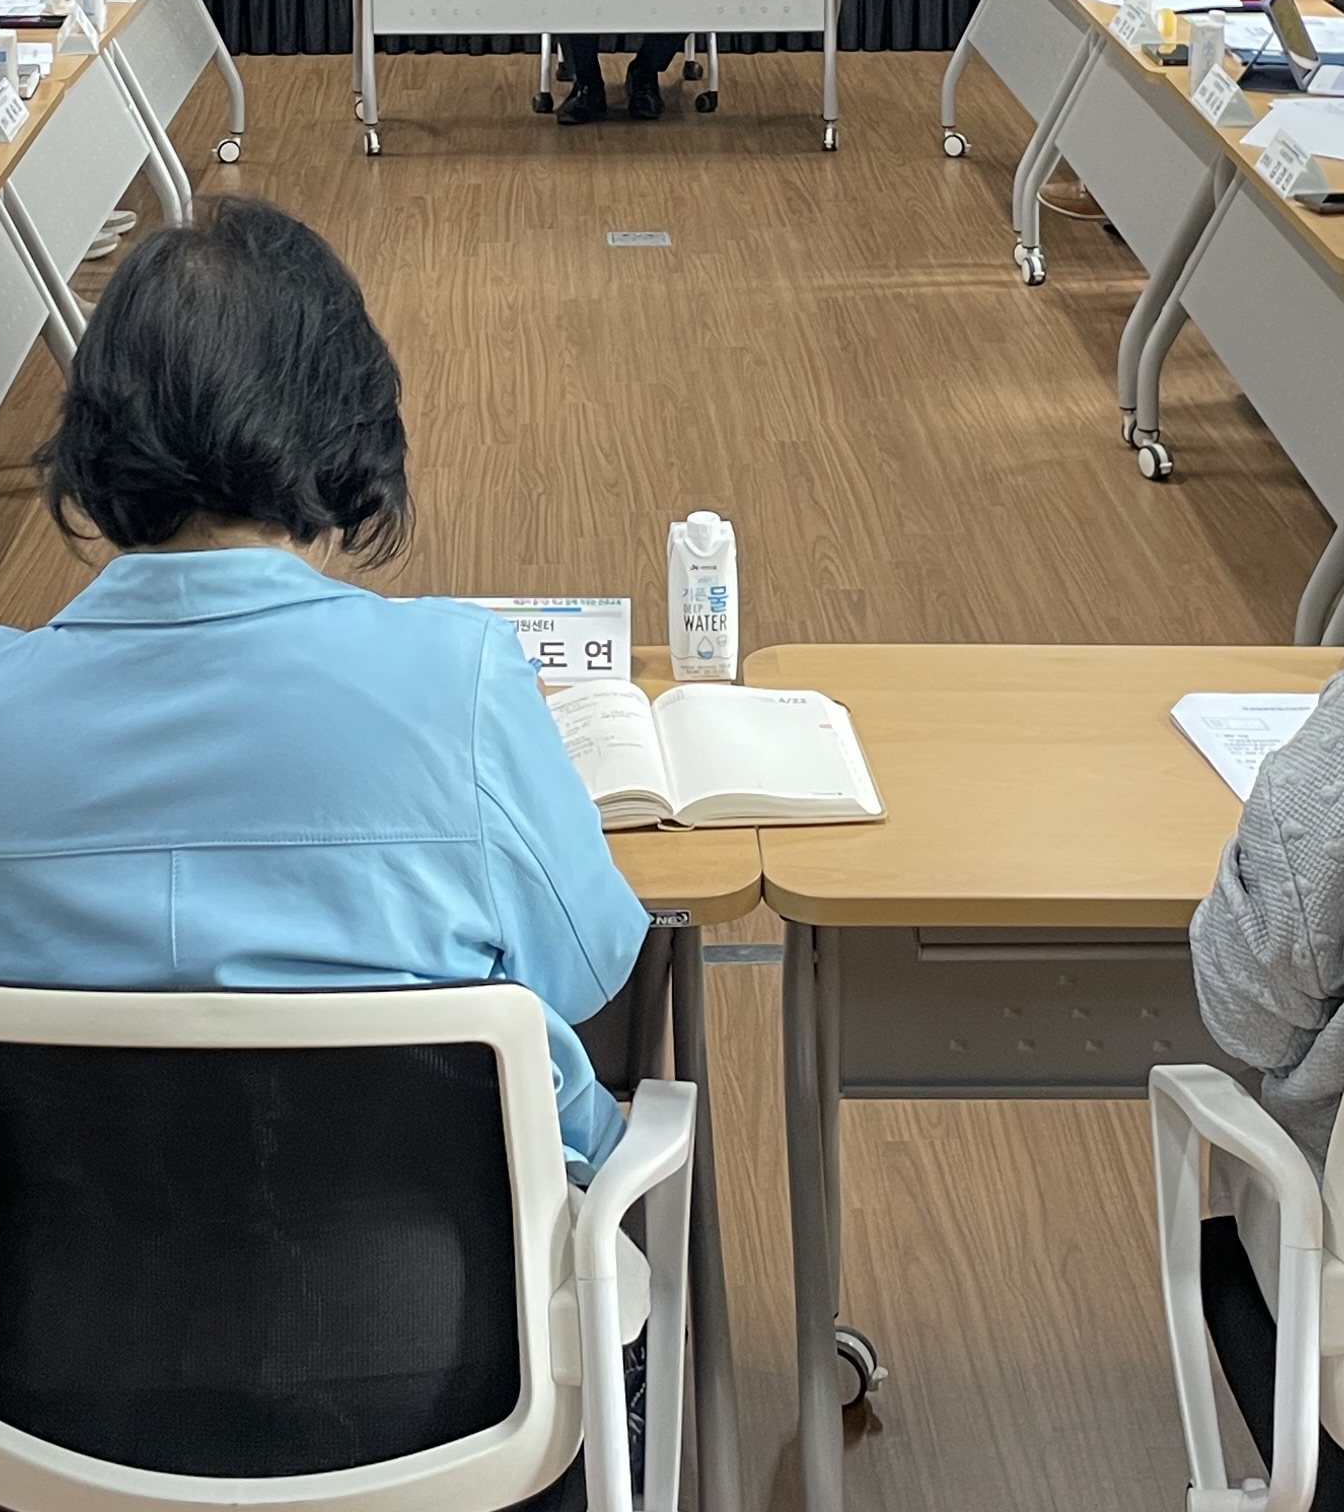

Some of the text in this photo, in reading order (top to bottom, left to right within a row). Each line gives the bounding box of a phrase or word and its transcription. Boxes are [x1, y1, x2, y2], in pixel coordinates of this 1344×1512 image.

[683, 603, 703, 614] DEEP
[707, 585, 729, 613] 물
[683, 614, 727, 632] WATER
[539, 639, 613, 671] 도 연
